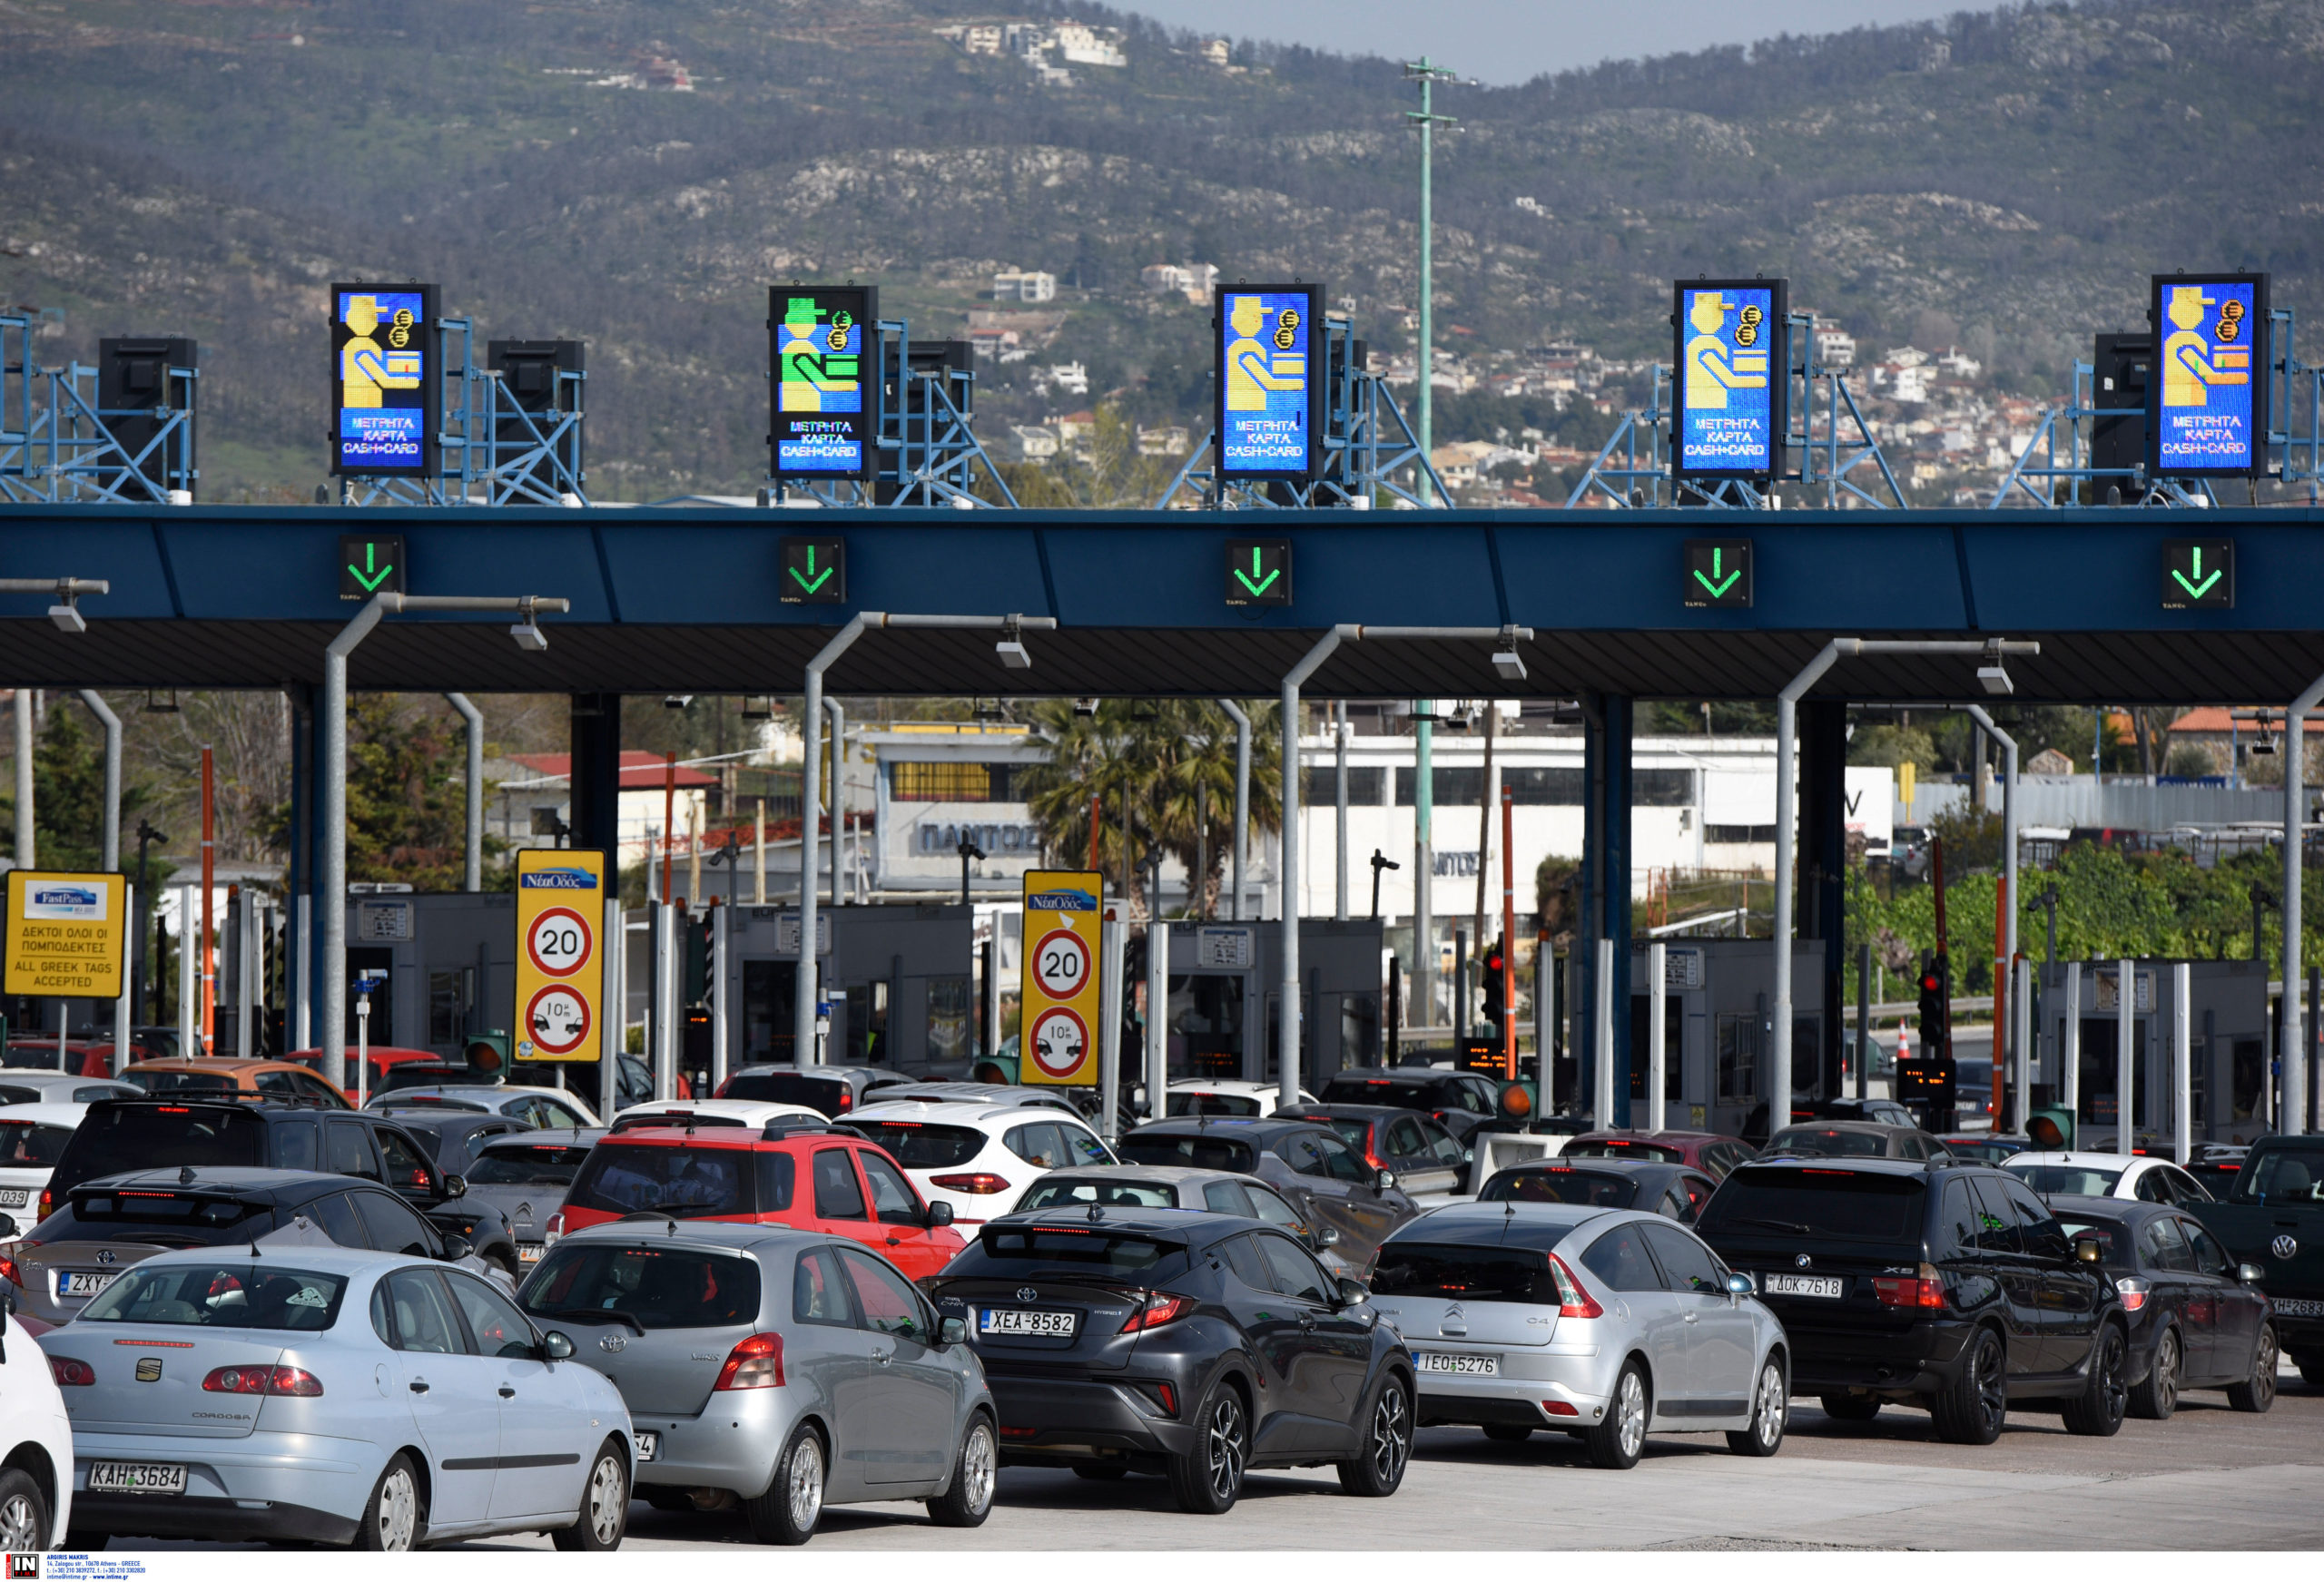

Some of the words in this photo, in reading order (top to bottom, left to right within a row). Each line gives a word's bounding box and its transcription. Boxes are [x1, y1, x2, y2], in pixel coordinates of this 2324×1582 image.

[352, 418, 415, 428] ΜΕΤΡΗΤΑ
[790, 421, 853, 432] ΜΕΤΡΗΤΑ
[1236, 420, 1299, 431] ΜΕΤΡΗΤΑ
[1695, 418, 1760, 429] ΜΕΤΡΗΤΑ
[2172, 416, 2242, 427] ΜΕΤΡΗΤΑ
[363, 430, 408, 441] ΚΑΡΤΑ
[801, 434, 845, 444] ΚΑΡΤΑ
[1247, 434, 1292, 444] ΚΑΡΤΑ
[1707, 432, 1753, 443] ΚΑΡΤΑ
[2185, 429, 2234, 440] ΚΑΡΤΑ
[42, 893, 83, 904] FastPass
[22, 927, 62, 938] ΔΕΚΤΟΙ
[67, 929, 93, 938] ΟΛΟΙ
[97, 929, 107, 938] ΟΙ
[22, 940, 105, 953] ΠΟΜΠΟΔΕΚΤΕΣ
[542, 929, 577, 955] 20
[15, 961, 35, 971] ALL
[41, 962, 78, 972] GREEK
[84, 963, 112, 974] TAGS
[1045, 952, 1078, 978] 20
[34, 976, 92, 988] ACCEPTED
[547, 1003, 563, 1017] 10
[1050, 1026, 1064, 1039] 10
[0, 1191, 25, 1204] 039
[192, 1412, 251, 1420] CORDOBA
